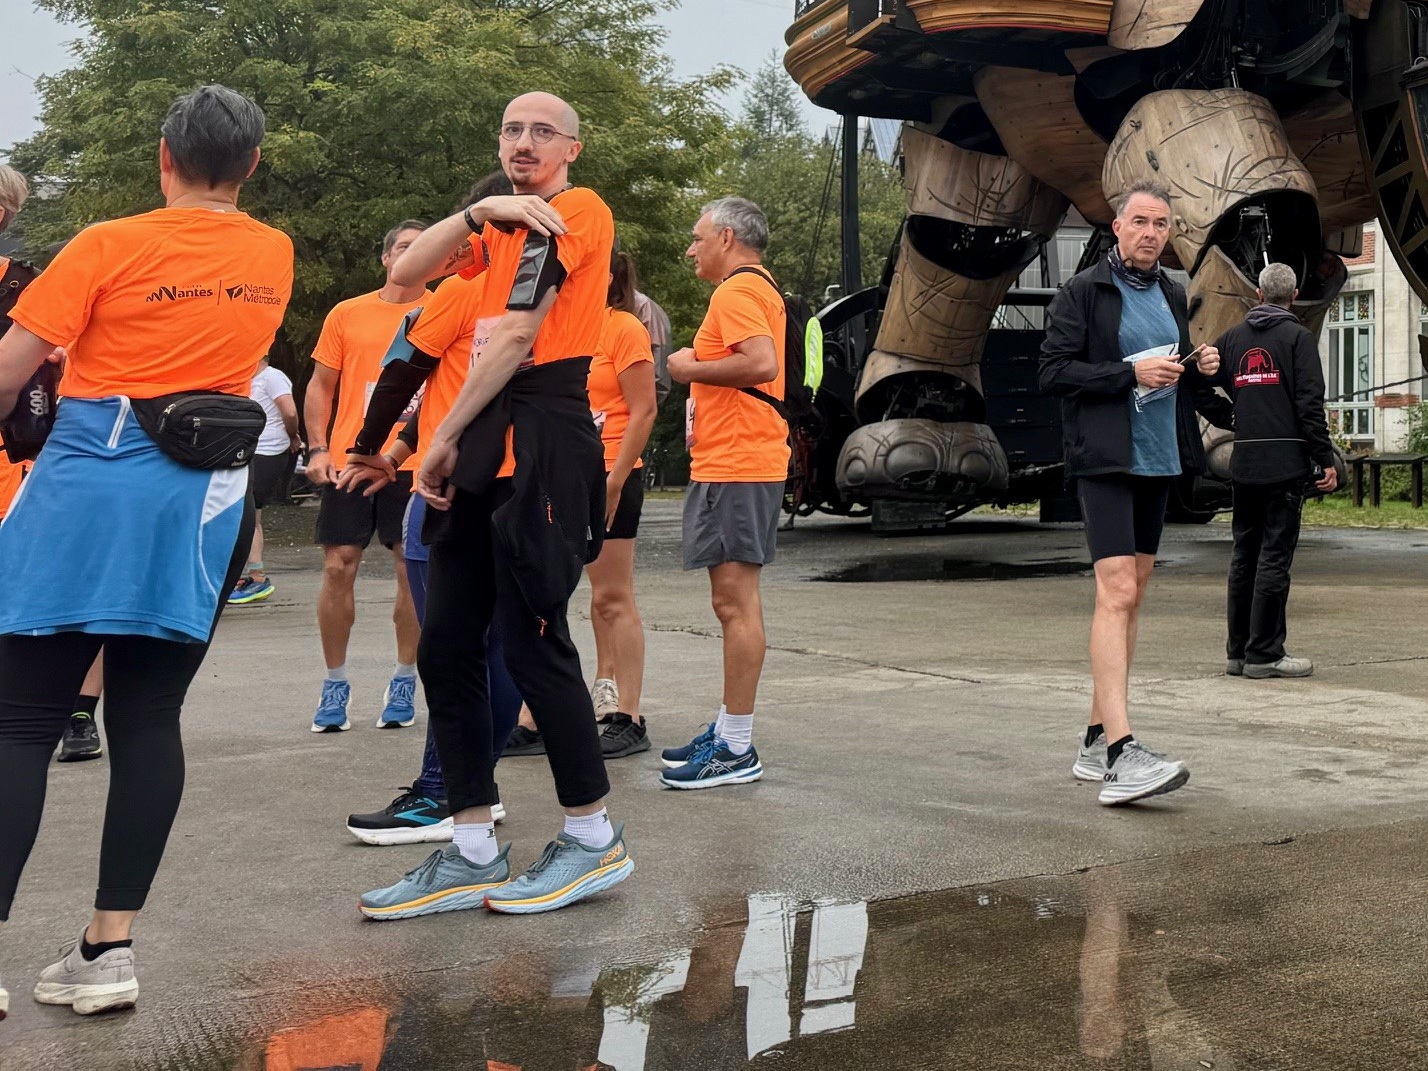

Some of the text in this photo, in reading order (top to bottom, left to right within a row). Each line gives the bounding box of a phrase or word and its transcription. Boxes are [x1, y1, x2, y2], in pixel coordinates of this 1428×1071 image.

[146, 286, 214, 303] Nantes
[244, 284, 275, 295] Nantes
[600, 844, 624, 867] HOKA
